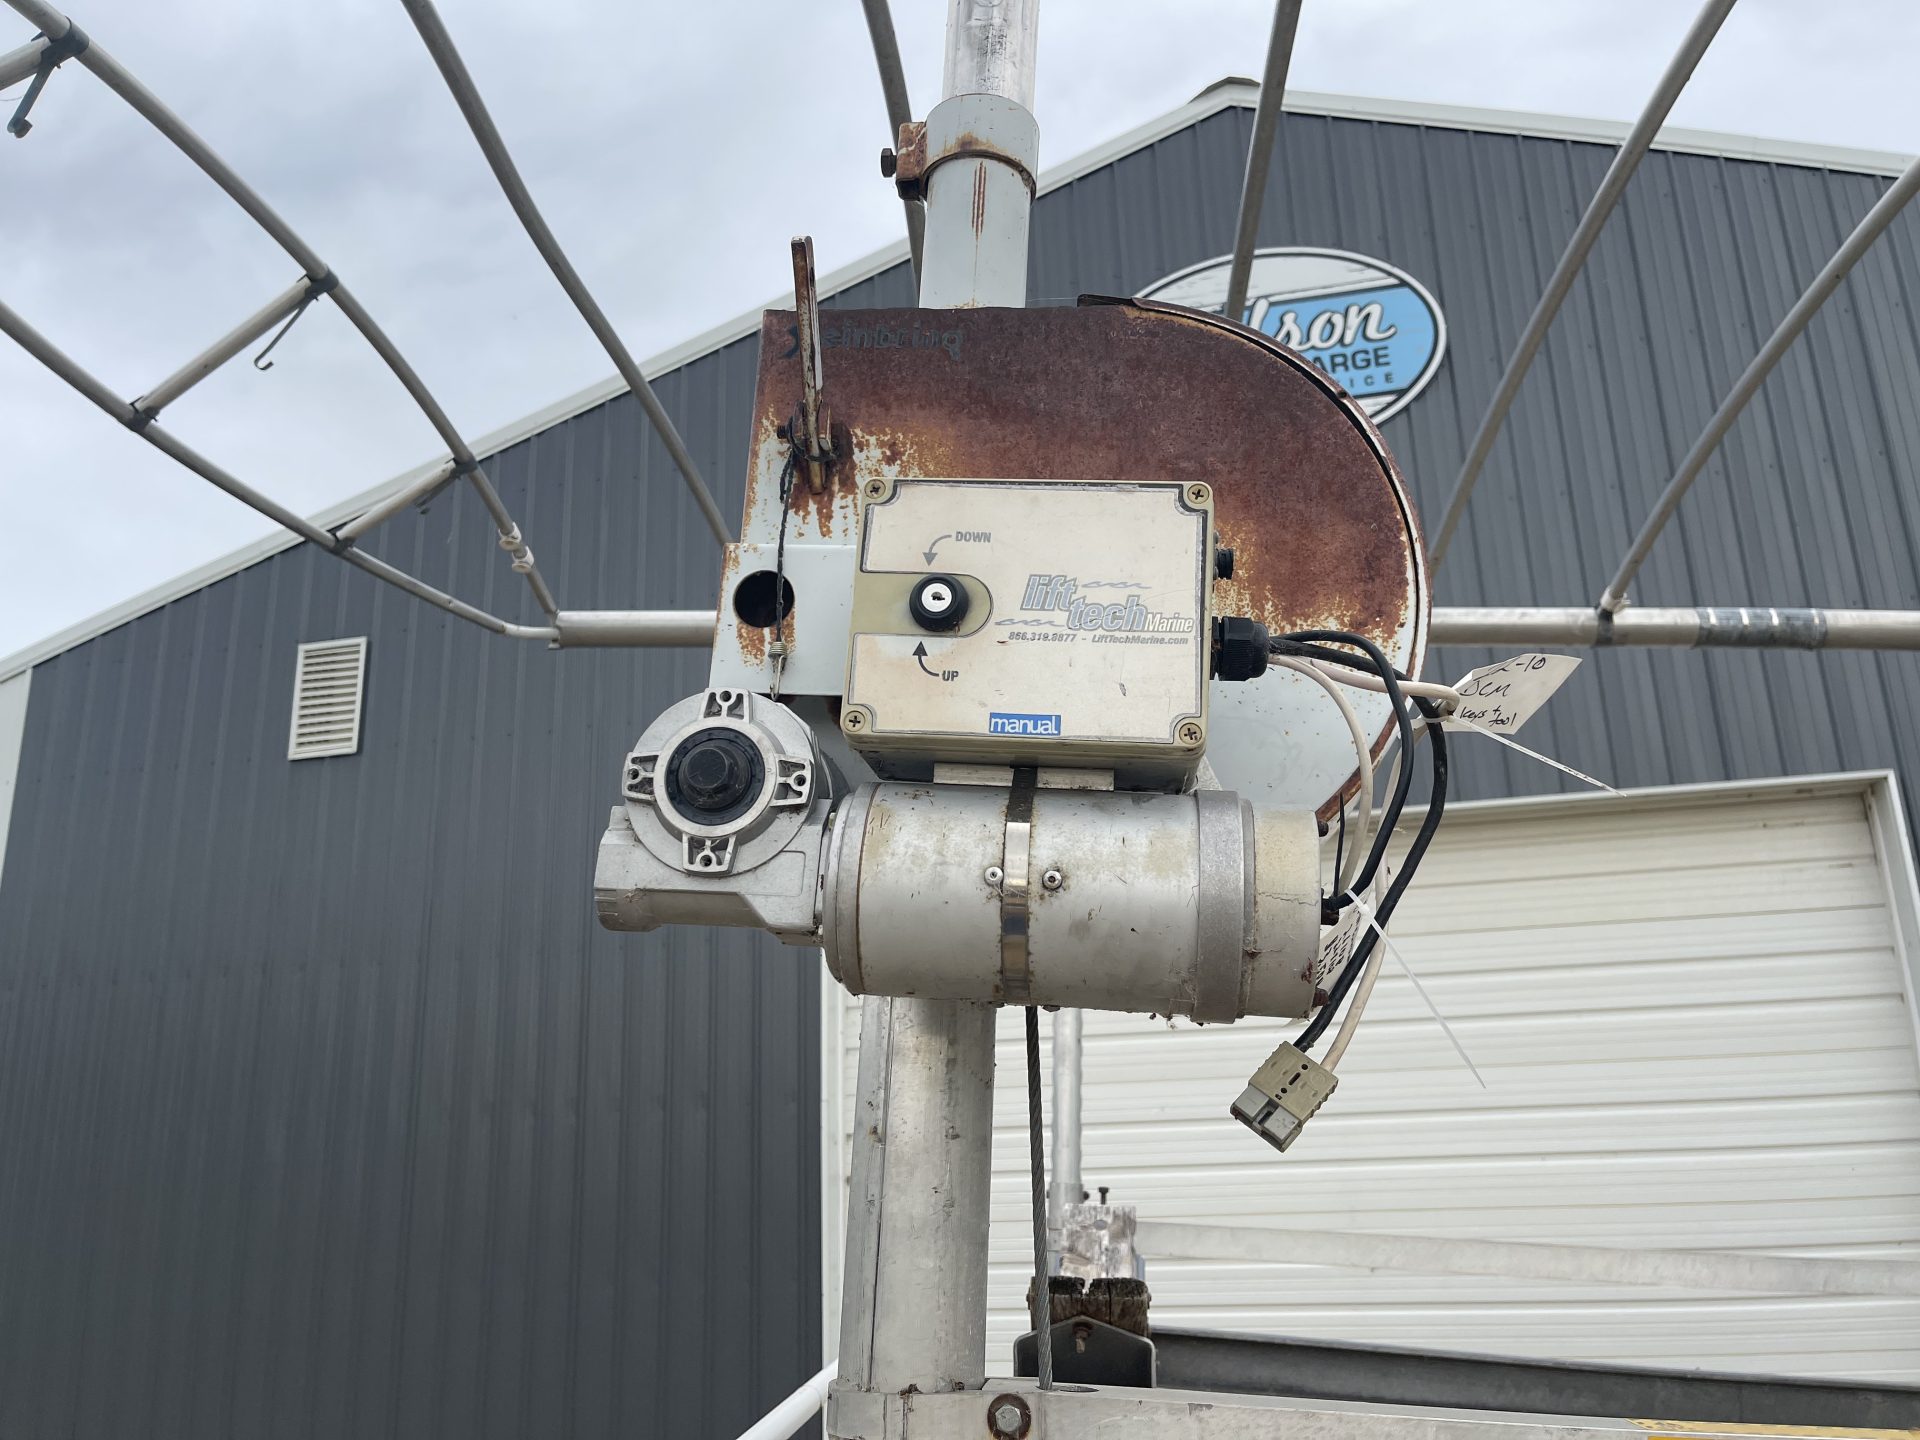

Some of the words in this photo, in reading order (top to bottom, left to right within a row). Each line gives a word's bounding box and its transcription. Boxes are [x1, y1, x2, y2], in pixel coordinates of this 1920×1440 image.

[1249, 297, 1398, 351] lson
[1312, 346, 1391, 376] ARGE
[955, 531, 992, 543] DOWN
[1066, 595, 1148, 632] tech
[1144, 612, 1195, 633] Marine
[1091, 633, 1189, 646] LiftTechMarine.com
[941, 670, 959, 682] UP
[991, 715, 1059, 735] manual
